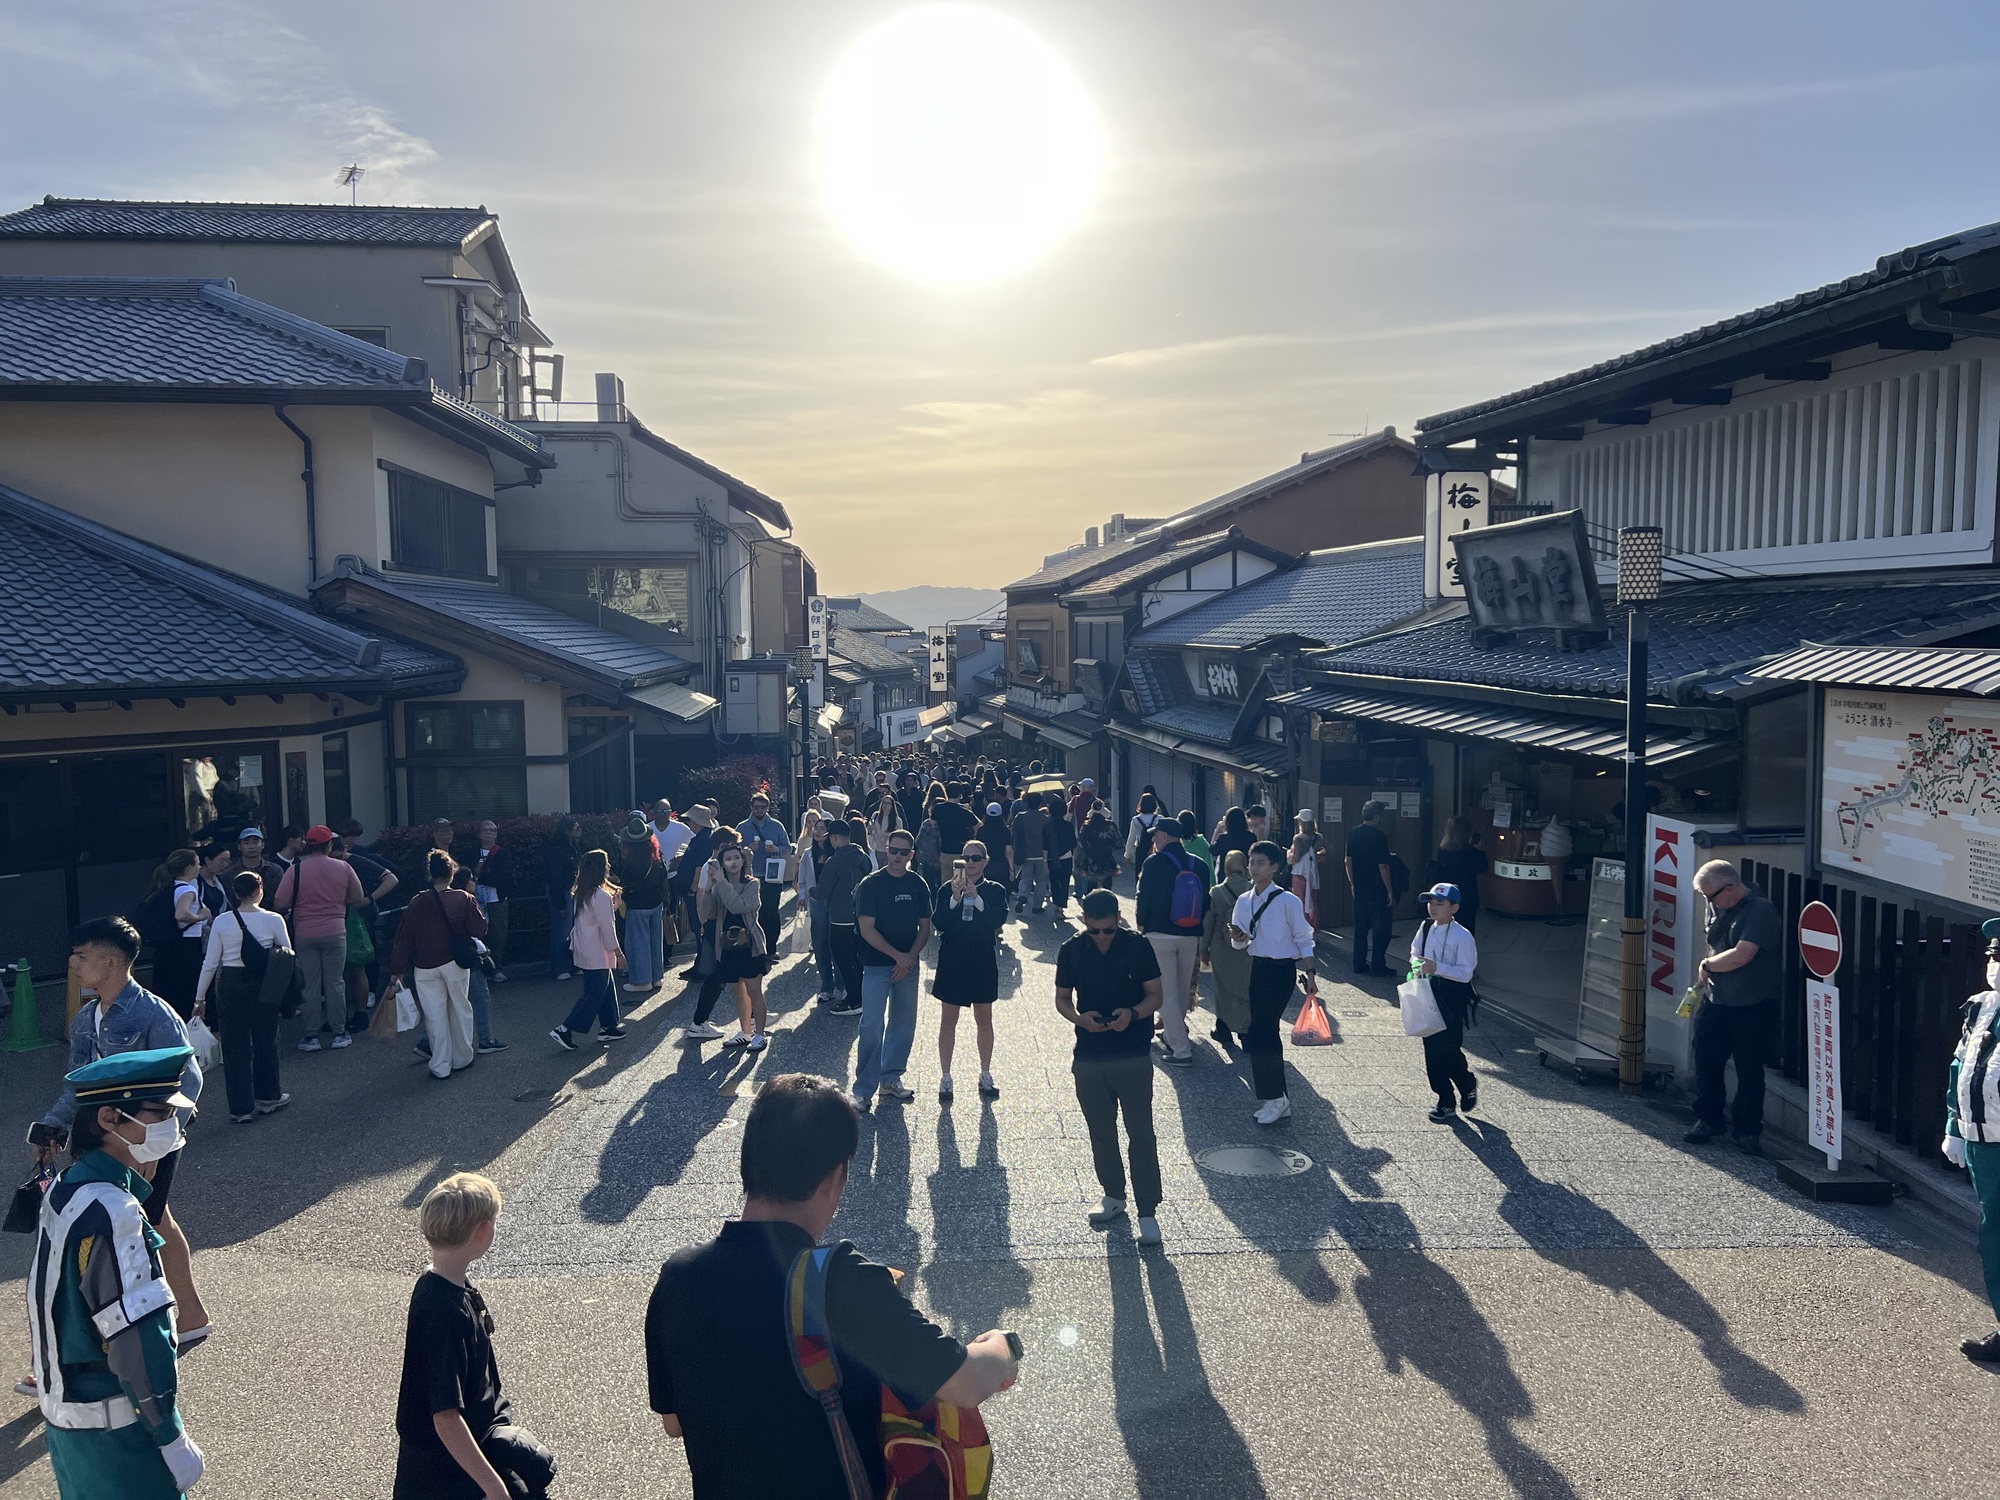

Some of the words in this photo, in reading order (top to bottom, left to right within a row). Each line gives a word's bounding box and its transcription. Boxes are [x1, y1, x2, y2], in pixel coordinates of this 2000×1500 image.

[931, 635, 946, 683] 梅山堂
[1870, 715, 1893, 728] 清水寺
[1651, 827, 1678, 996] KIRIN
[1824, 993, 1835, 1146] 許可車両以外進入禁止
